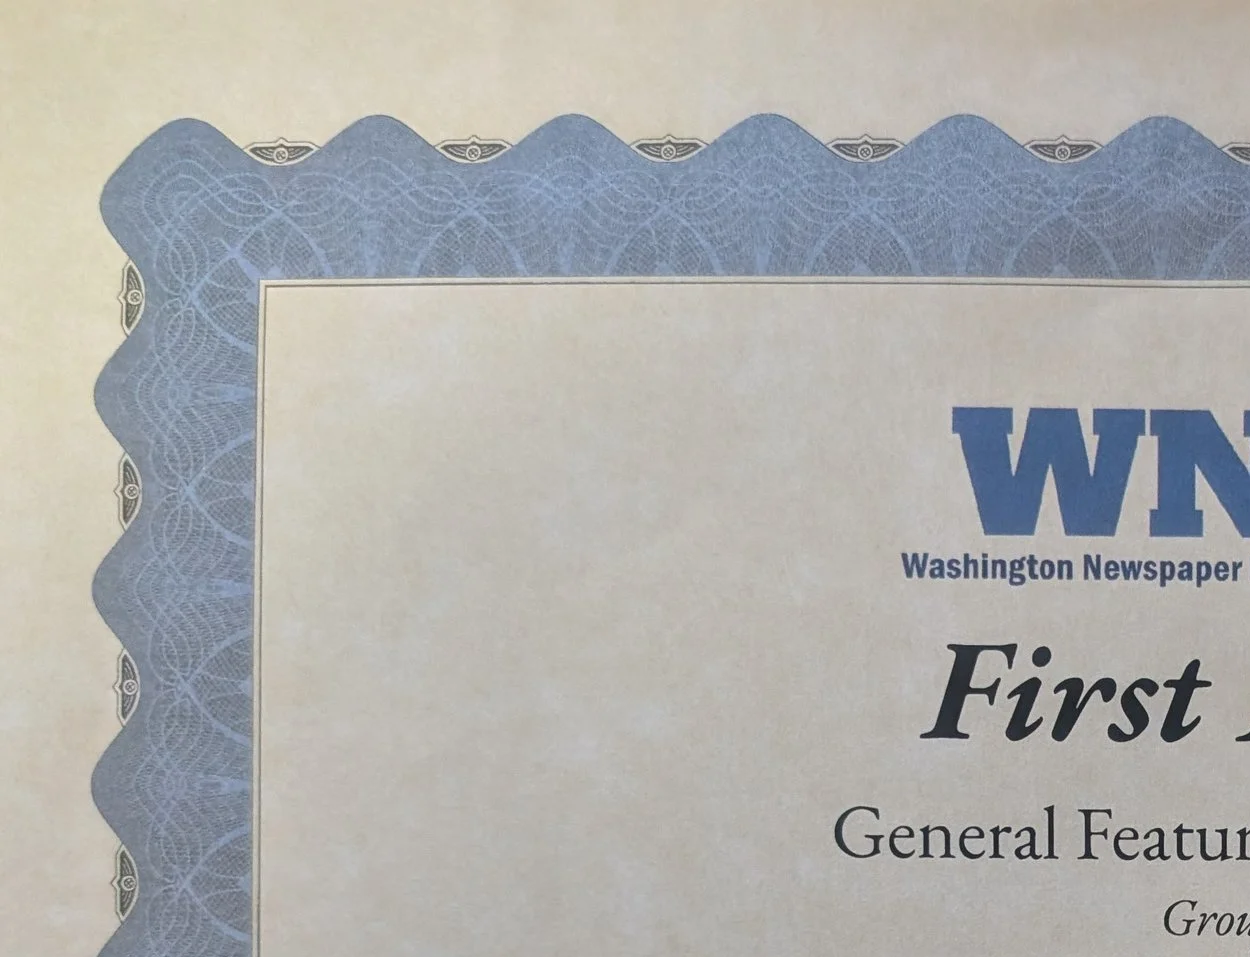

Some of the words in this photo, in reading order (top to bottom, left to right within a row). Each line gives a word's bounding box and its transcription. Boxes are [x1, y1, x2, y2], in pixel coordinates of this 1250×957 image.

[901, 553, 1073, 587] Washington
[1083, 555, 1243, 588] Newspaper
[920, 640, 1212, 744] First
[834, 805, 1059, 860] General
